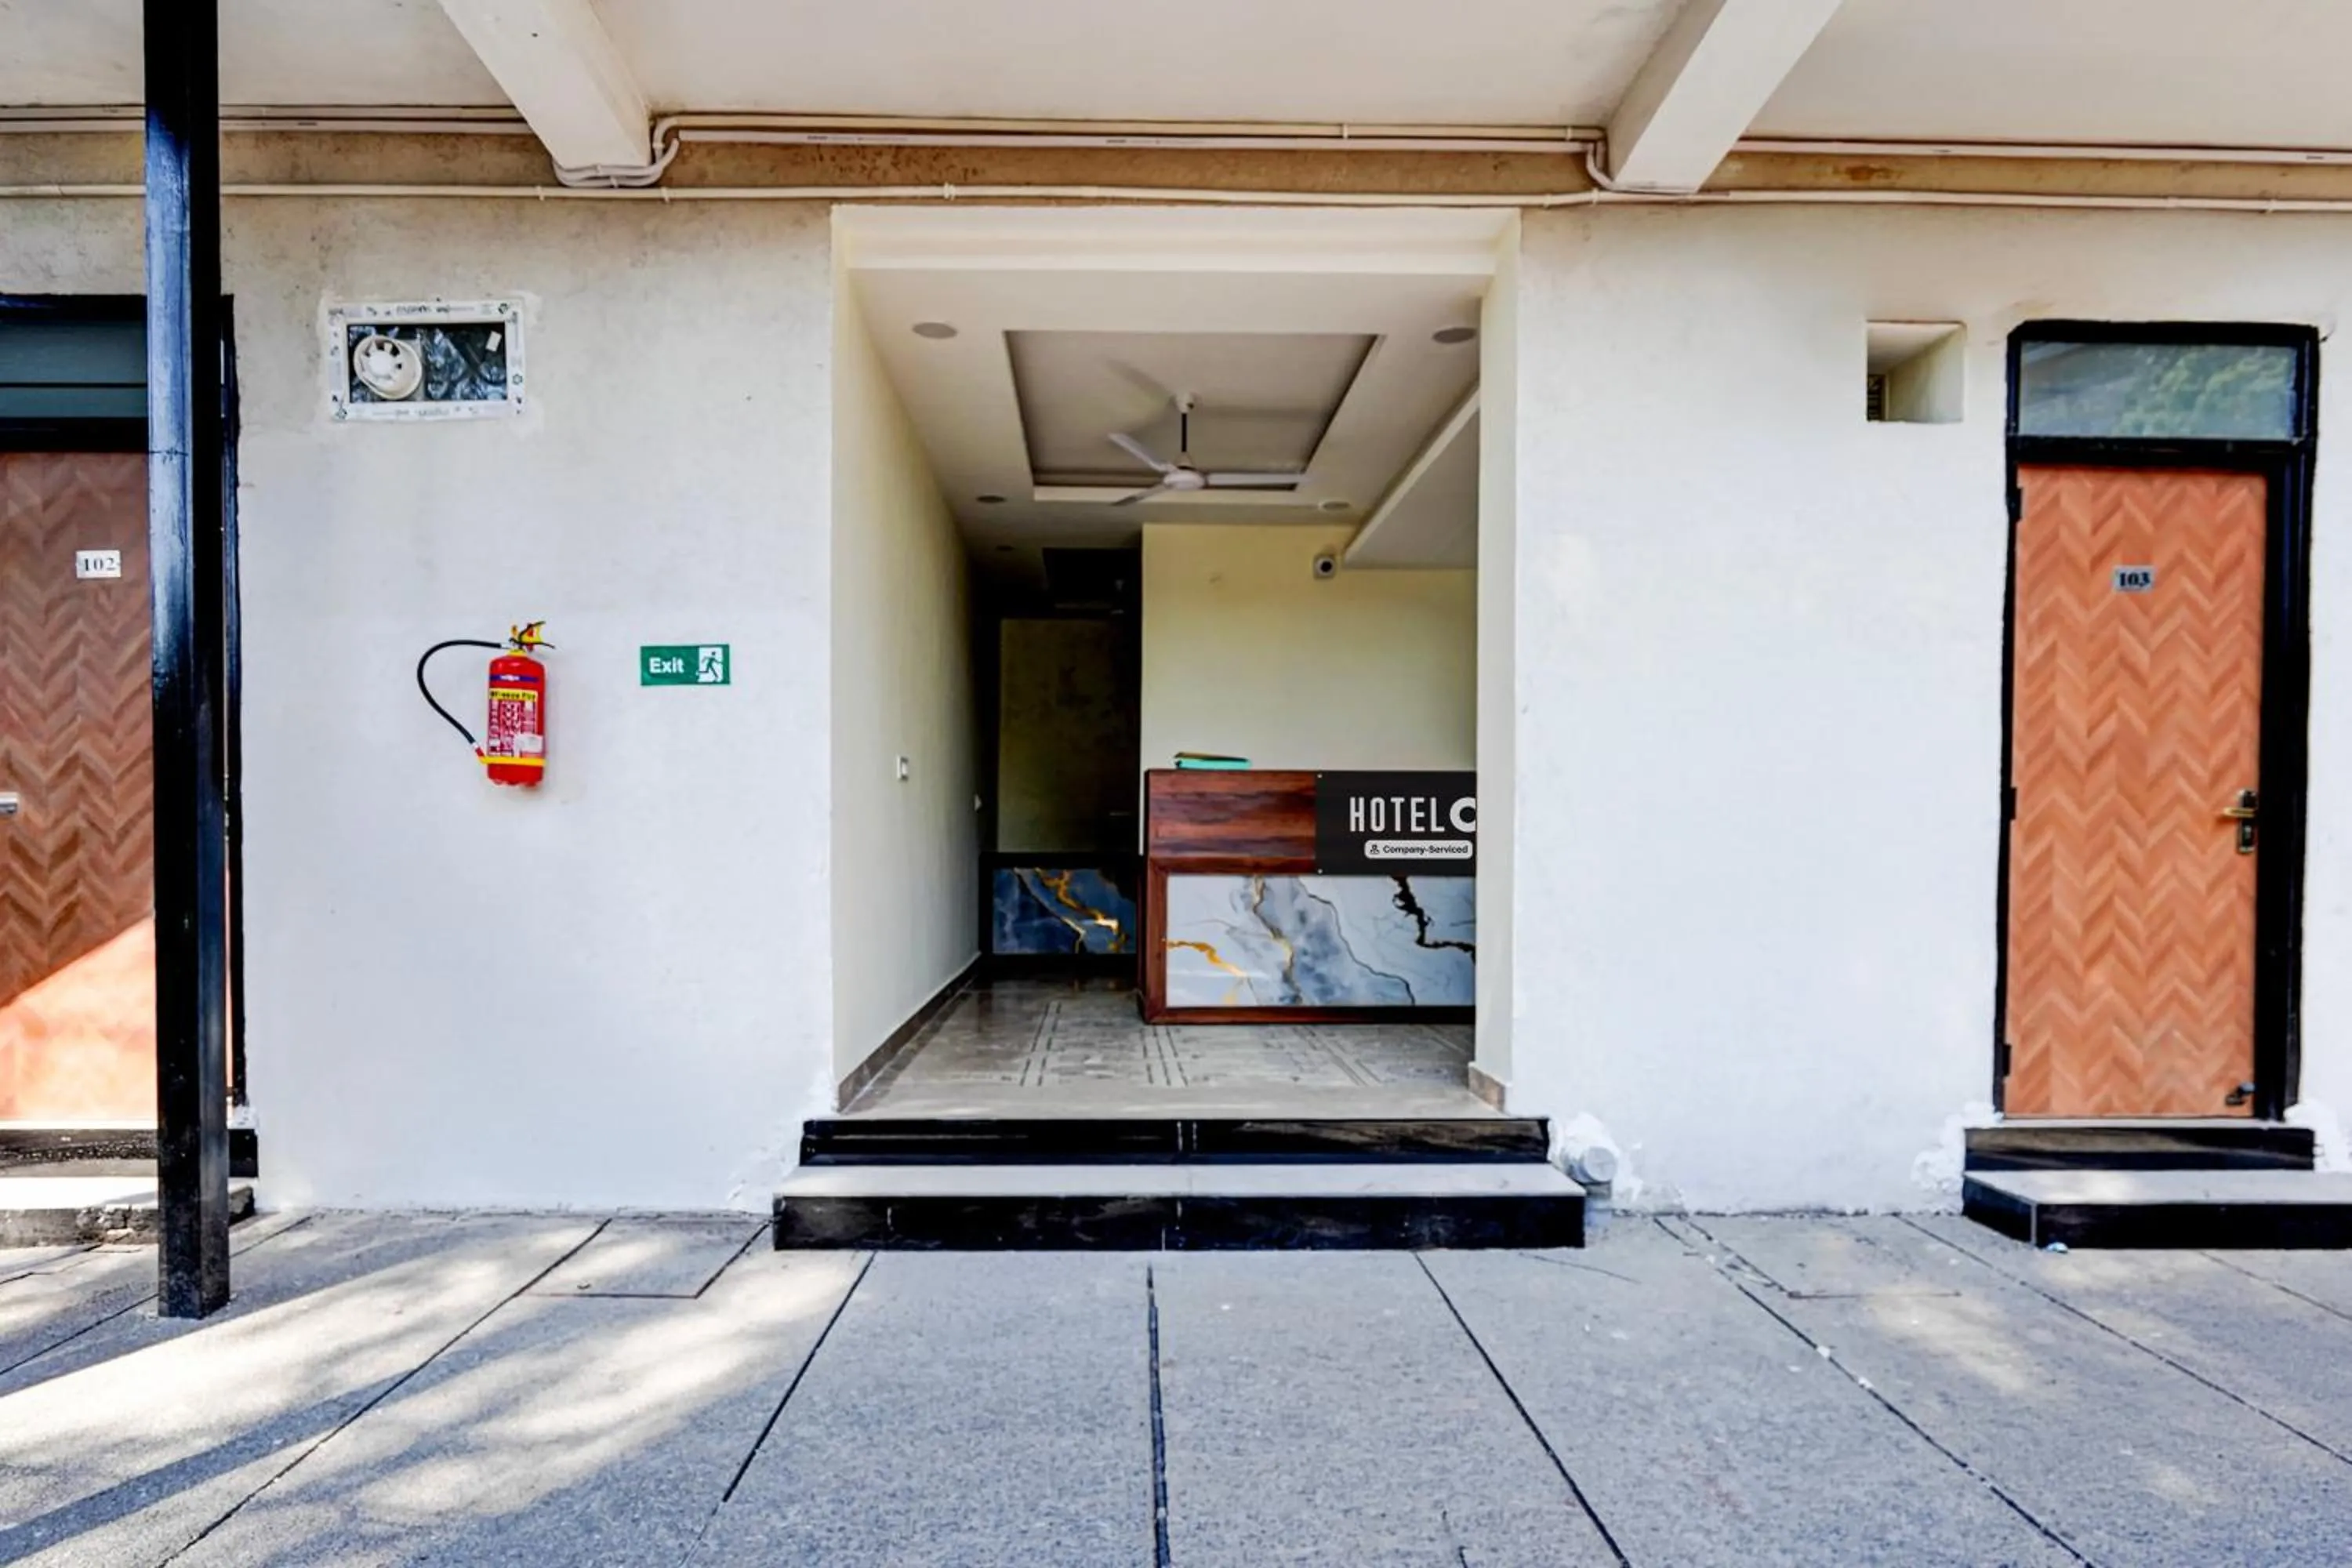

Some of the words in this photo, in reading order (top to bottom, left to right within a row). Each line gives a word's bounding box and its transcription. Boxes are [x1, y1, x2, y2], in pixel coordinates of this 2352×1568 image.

[84, 557, 117, 572] 102
[2120, 572, 2151, 587] 103
[649, 656, 684, 673] Exit
[1349, 797, 1446, 832] HOTEL
[1382, 844, 1468, 855] Company-Serviced
